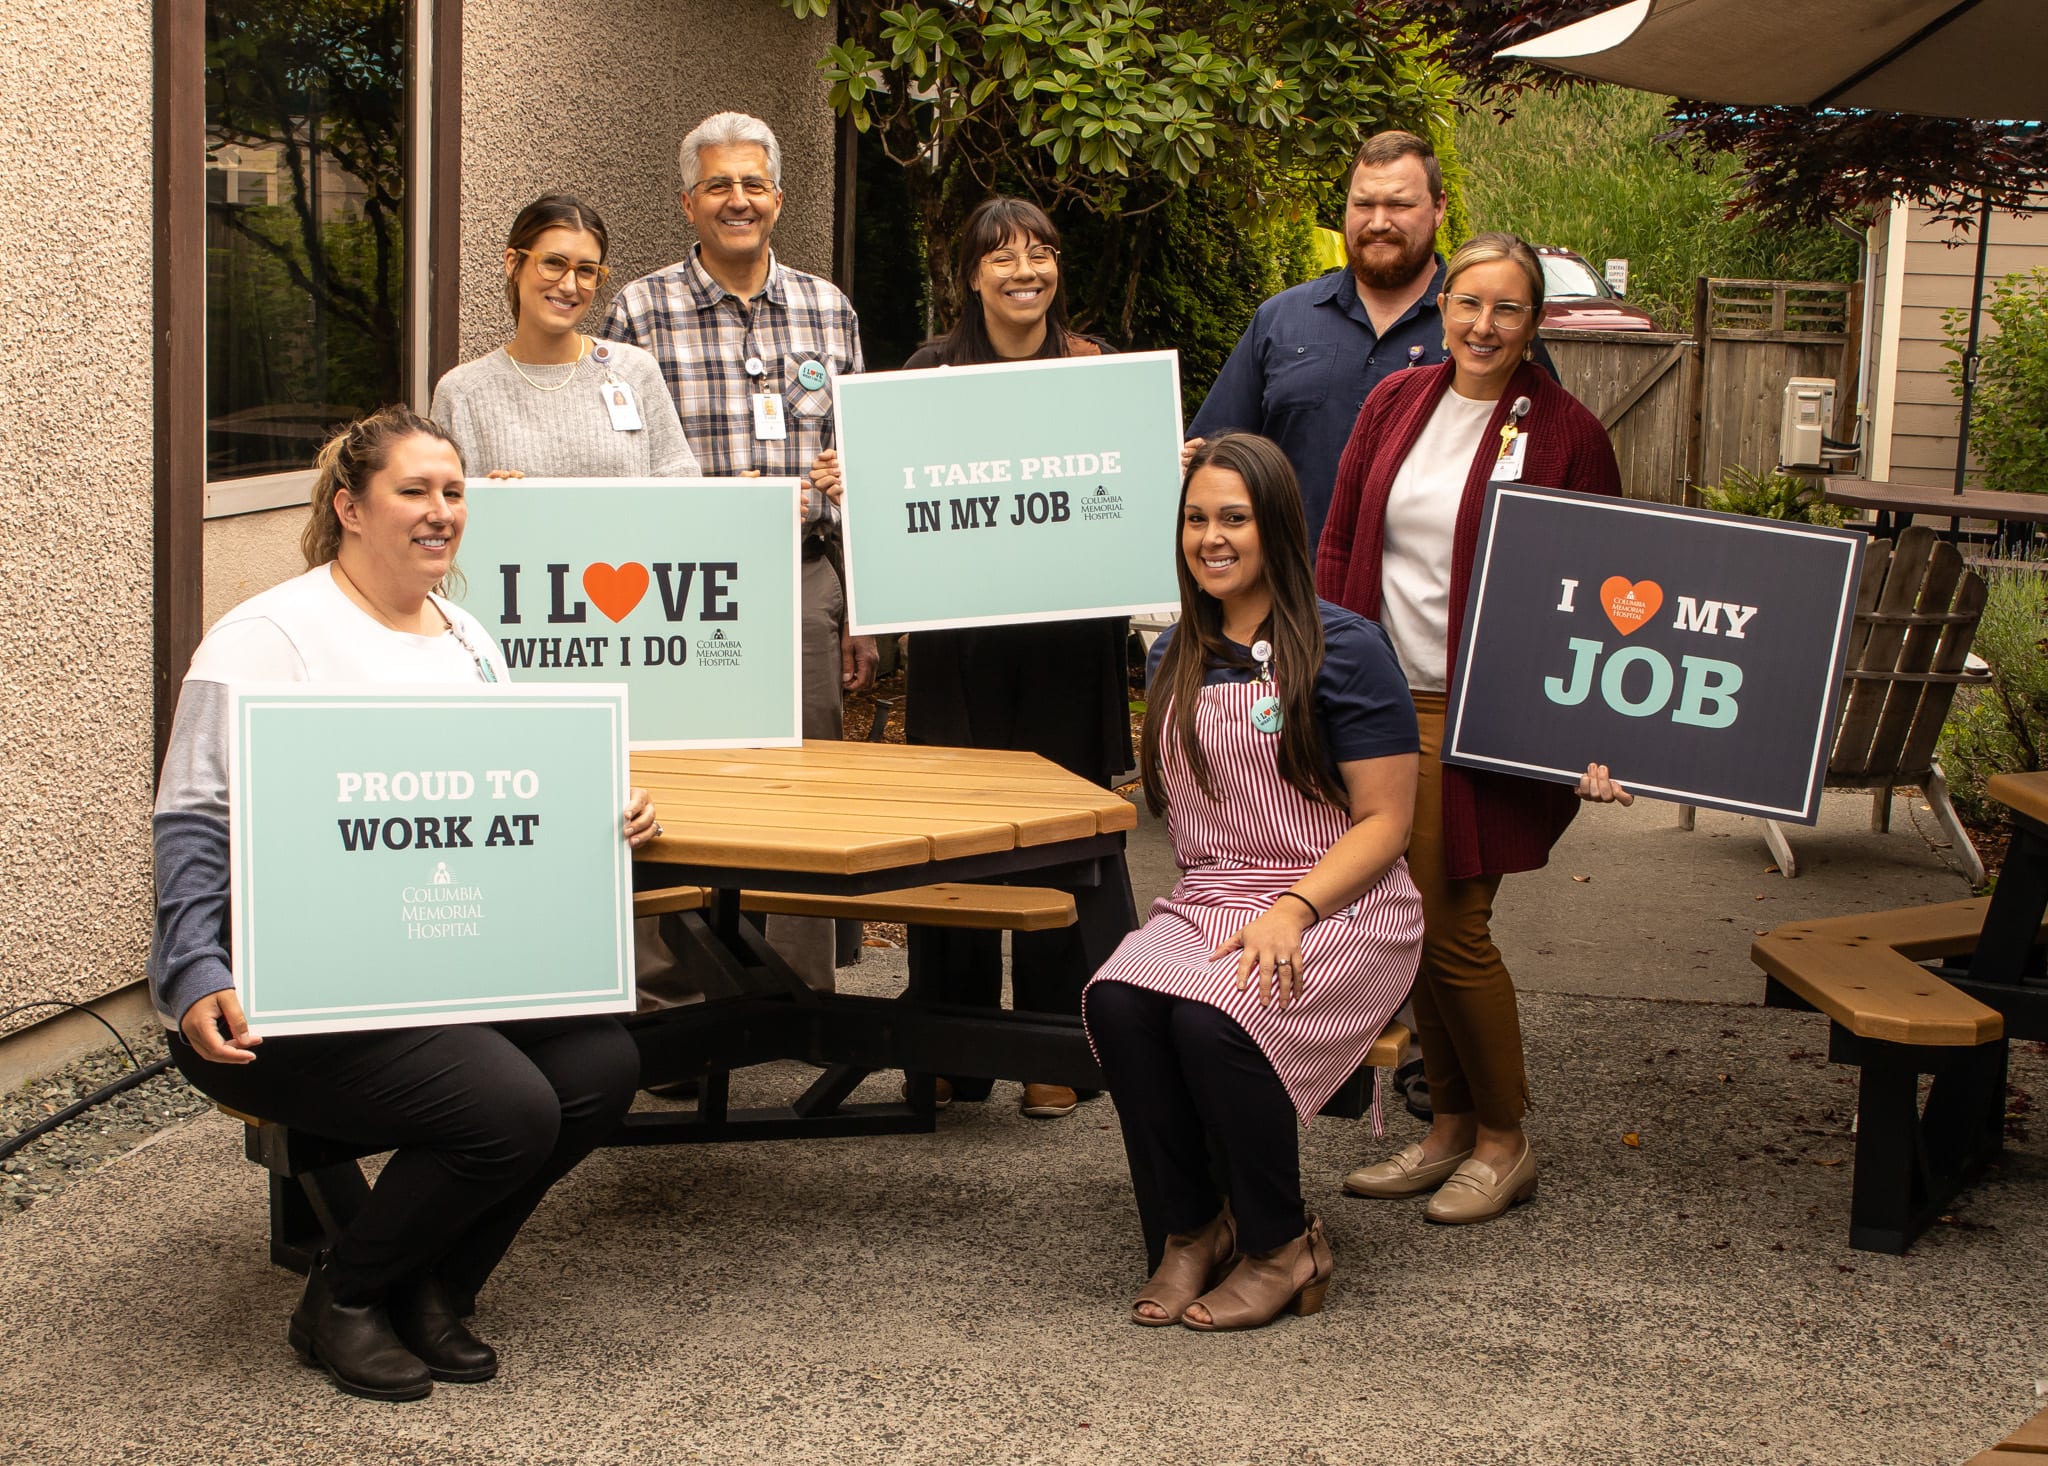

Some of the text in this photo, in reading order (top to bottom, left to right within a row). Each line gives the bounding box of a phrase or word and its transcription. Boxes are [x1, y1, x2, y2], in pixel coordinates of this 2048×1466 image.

[903, 451, 1121, 489] I TAKE PRIDE
[906, 491, 1070, 533] IN MY JOB
[500, 564, 521, 624] I
[1557, 579, 1758, 639] I MY
[501, 635, 687, 668] WHAT I DO
[1544, 637, 1743, 729] JOB
[337, 769, 539, 802] PROUD TO
[338, 814, 539, 851] WORK AT
